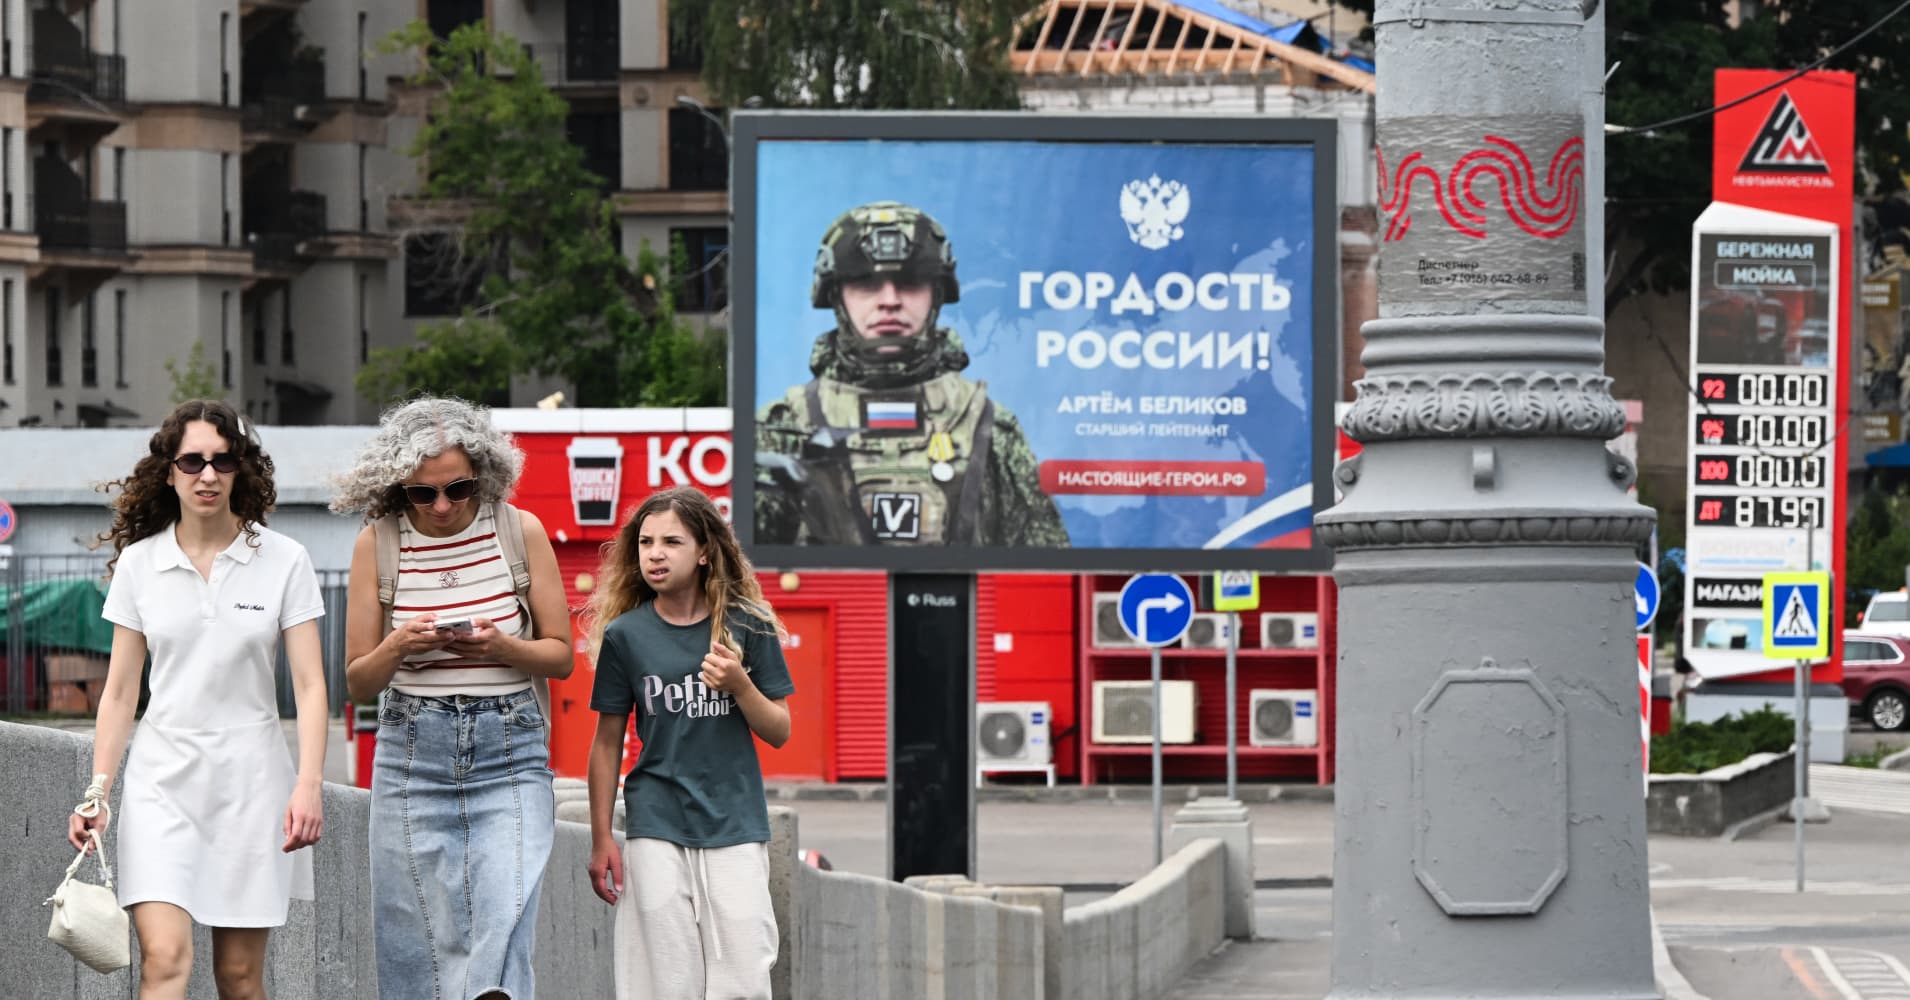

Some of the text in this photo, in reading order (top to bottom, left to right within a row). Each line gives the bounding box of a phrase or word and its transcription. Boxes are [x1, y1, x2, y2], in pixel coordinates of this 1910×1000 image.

[1717, 242, 1814, 259] БЕРЕЖНАЯ
[1733, 265, 1797, 284] МОЙКА
[1018, 271, 1291, 315] ГОРДОСТЬ
[1036, 329, 1270, 371] РОССИИ!
[1702, 373, 1823, 407] 92 00.00
[1057, 391, 1248, 415] АРТЁМ БЕЛИКОВ
[1075, 420, 1229, 437] СТАРШИЙ ЛЕЙТЕНАНТ
[1737, 414, 1822, 448] 00.00
[1058, 470, 1247, 487] НАСТОЯЩИЕ-ГЕРОИ.РФ
[1700, 460, 1729, 480] 100
[880, 499, 913, 532] V
[1698, 496, 1819, 529] ДТ 87.99
[922, 593, 957, 607] Russ
[687, 695, 730, 719] chou
